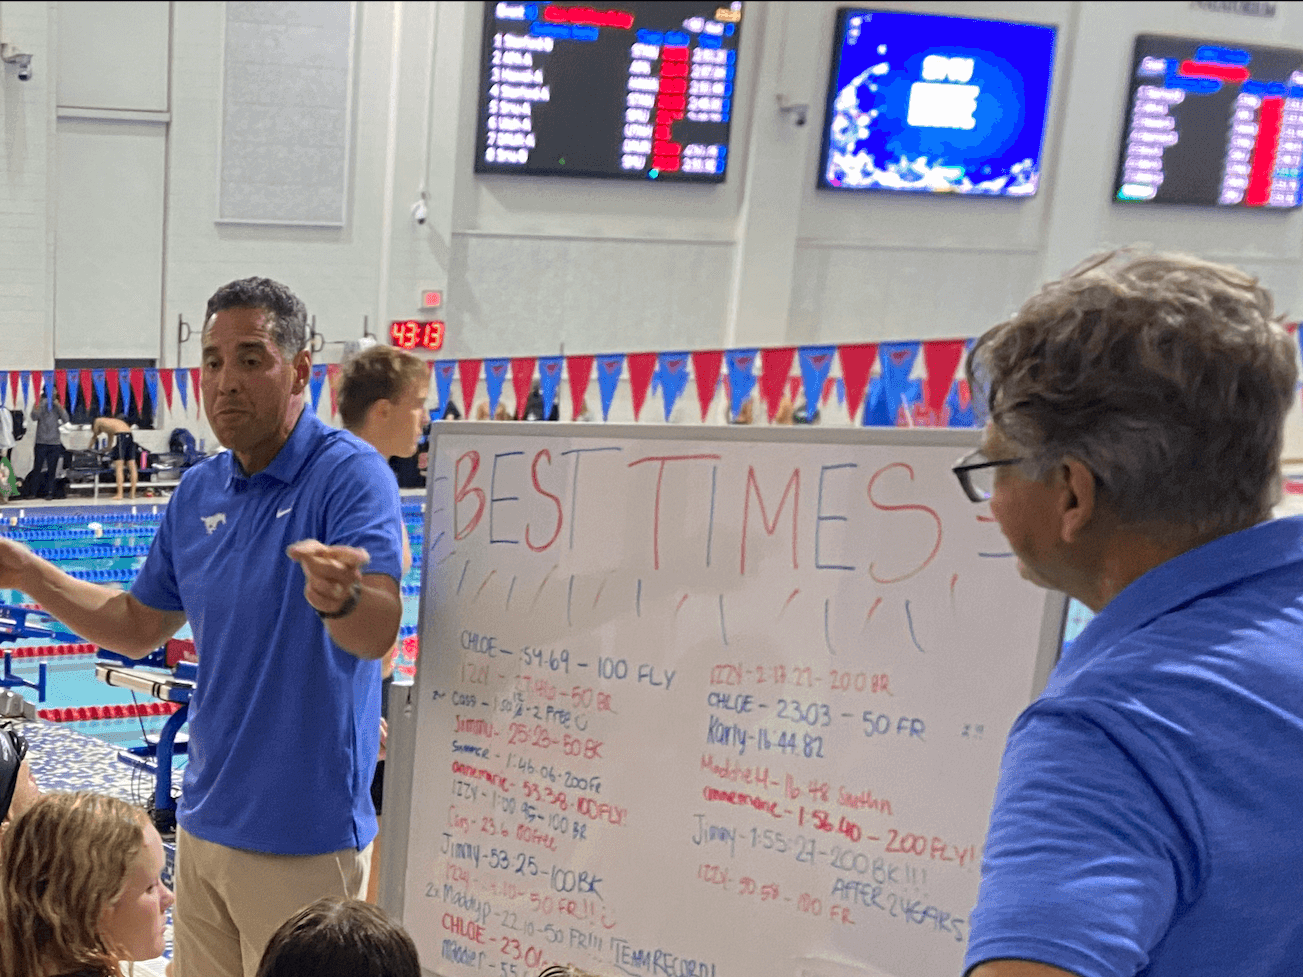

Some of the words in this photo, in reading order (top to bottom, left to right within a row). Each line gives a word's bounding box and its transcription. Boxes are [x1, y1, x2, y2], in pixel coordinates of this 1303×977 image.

[391, 321, 445, 347] 43:13
[454, 448, 623, 552] BEST
[628, 454, 943, 584] TIMES
[597, 656, 628, 679] 100
[638, 663, 677, 690] FLY
[707, 691, 754, 714] CHLOE
[862, 710, 891, 738] 50
[897, 716, 927, 742] FR
[441, 912, 486, 945] CHLOE
